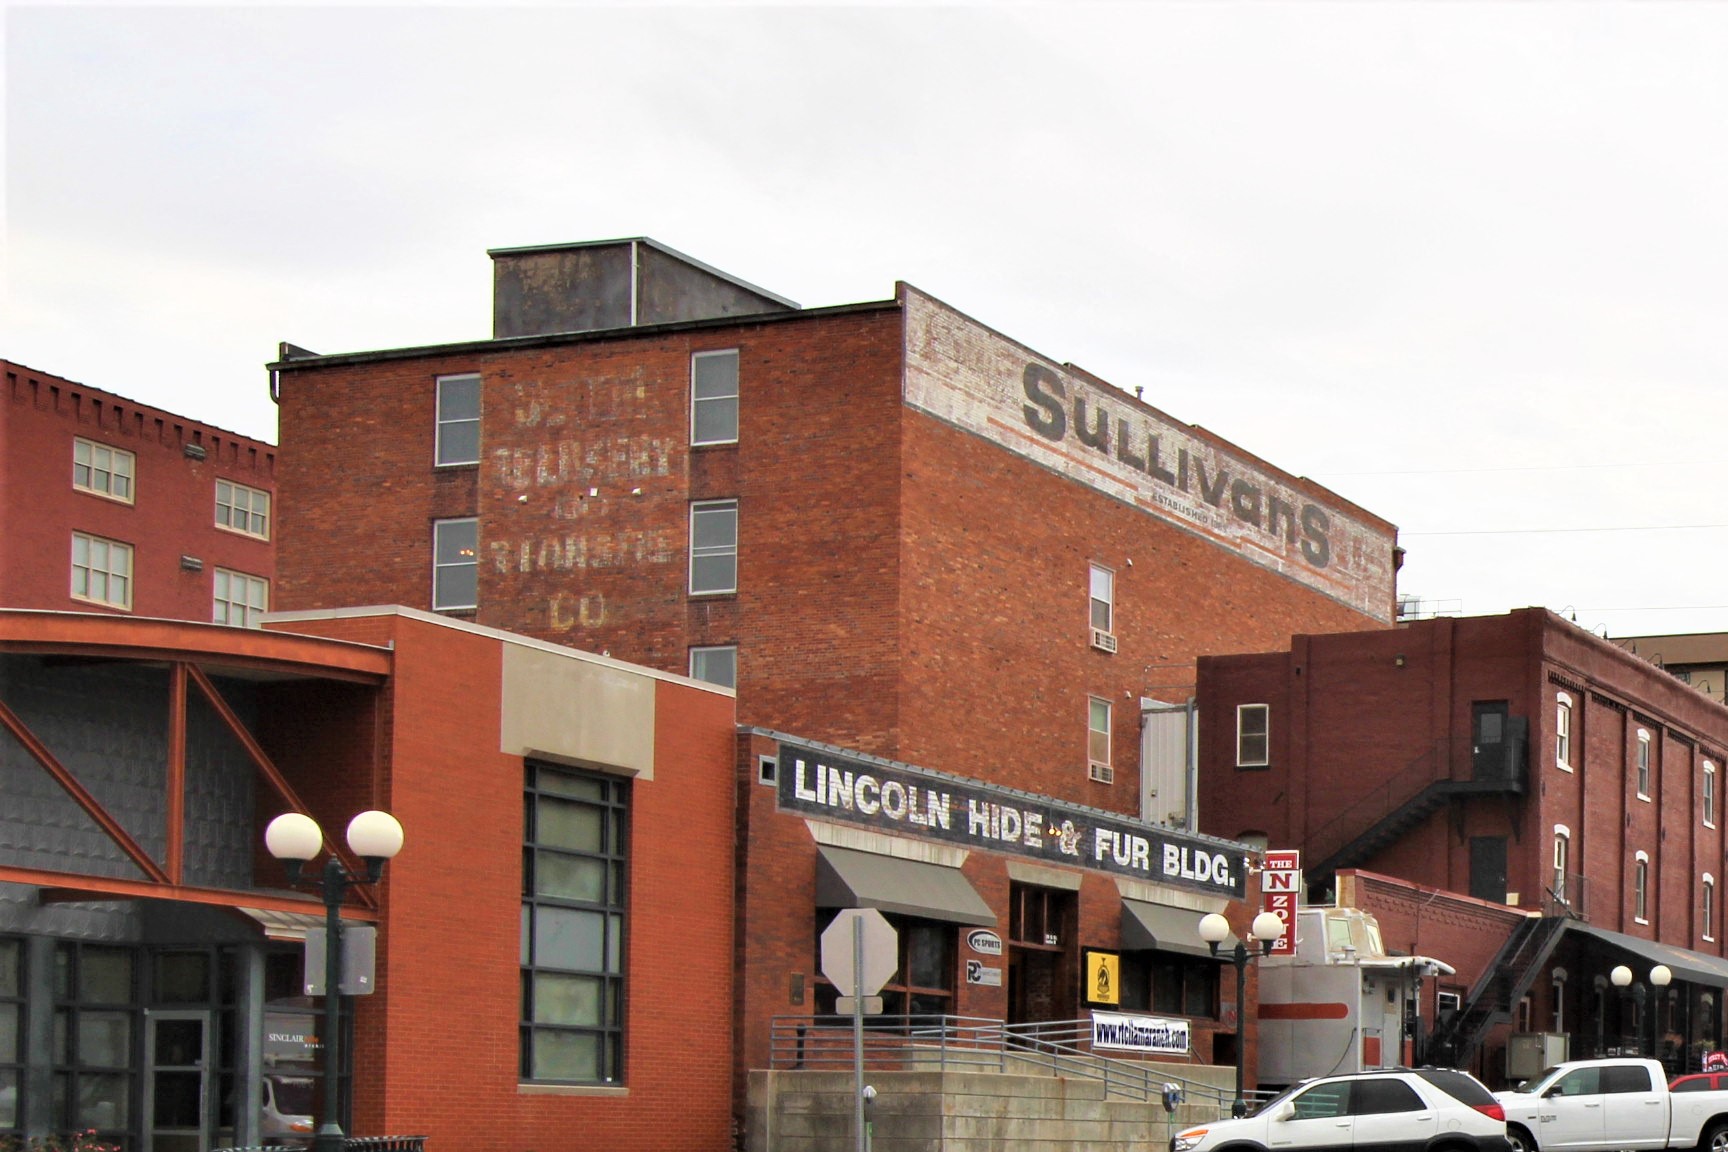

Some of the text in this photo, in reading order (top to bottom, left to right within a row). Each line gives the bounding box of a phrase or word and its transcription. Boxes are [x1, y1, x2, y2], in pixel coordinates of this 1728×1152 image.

[1152, 493, 1208, 524] ESTABLISHED
[795, 759, 1235, 887] LINCOLN HIDE & FUR BLDG.
[1270, 860, 1292, 869] THE
[1269, 873, 1292, 889] N
[981, 939, 1000, 949] SPORTS
